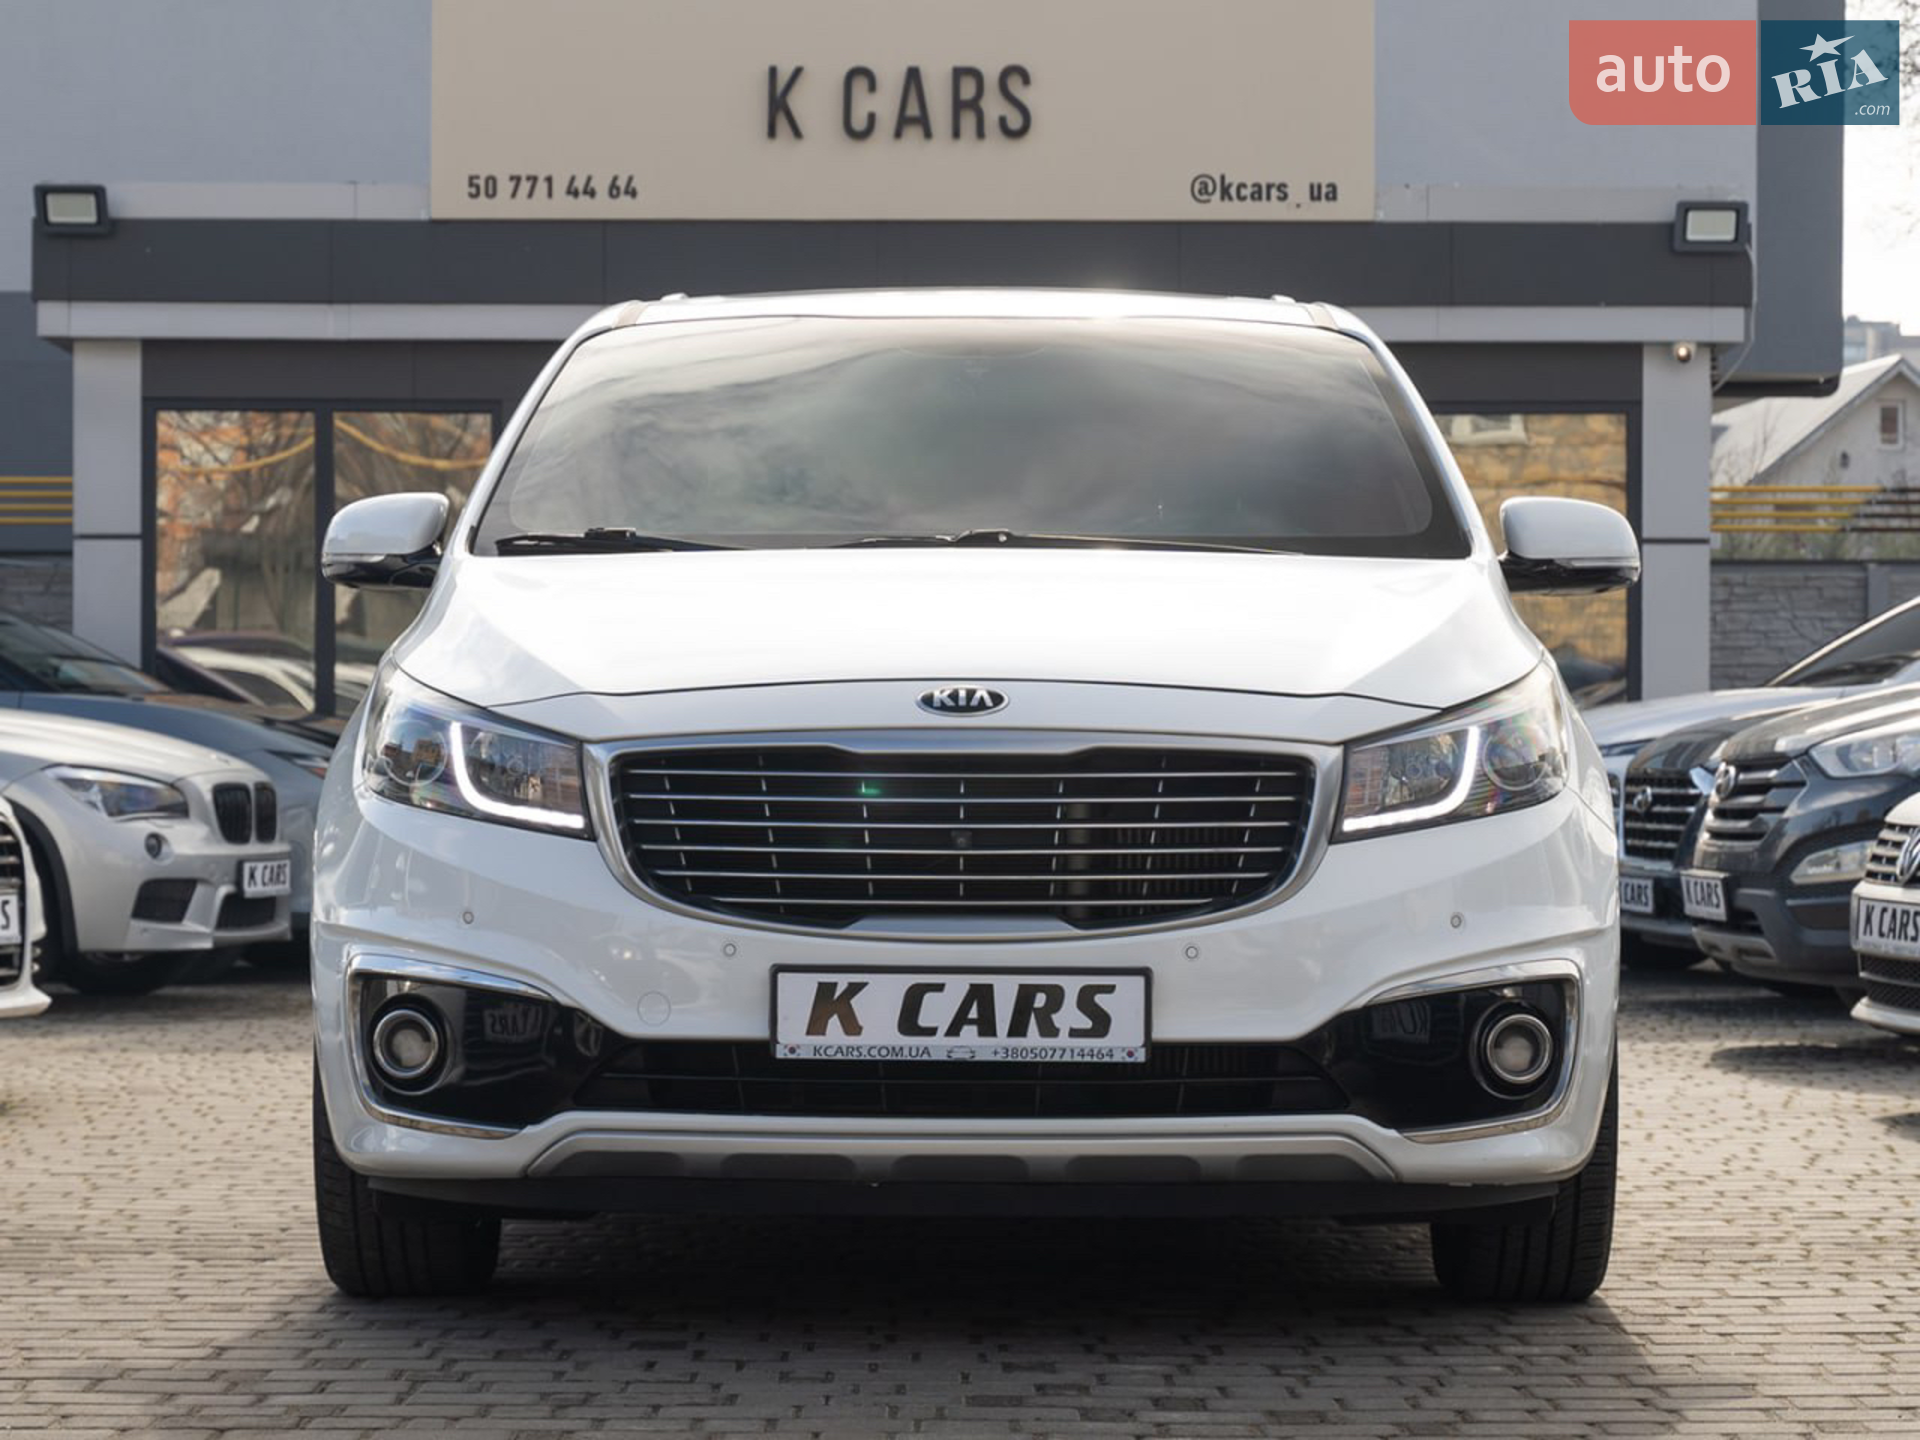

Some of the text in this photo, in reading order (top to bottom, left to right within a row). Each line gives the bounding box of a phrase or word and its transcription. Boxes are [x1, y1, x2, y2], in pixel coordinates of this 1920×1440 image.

[767, 64, 1032, 141] K CARS
[468, 175, 638, 199] 50 771 44 64
[933, 689, 994, 707] KIA
[248, 863, 287, 888] K CARS
[1863, 904, 1875, 937] K
[805, 981, 1117, 1038] K CARS
[813, 1046, 1115, 1060] KCARS.COM.UA +380507714464
